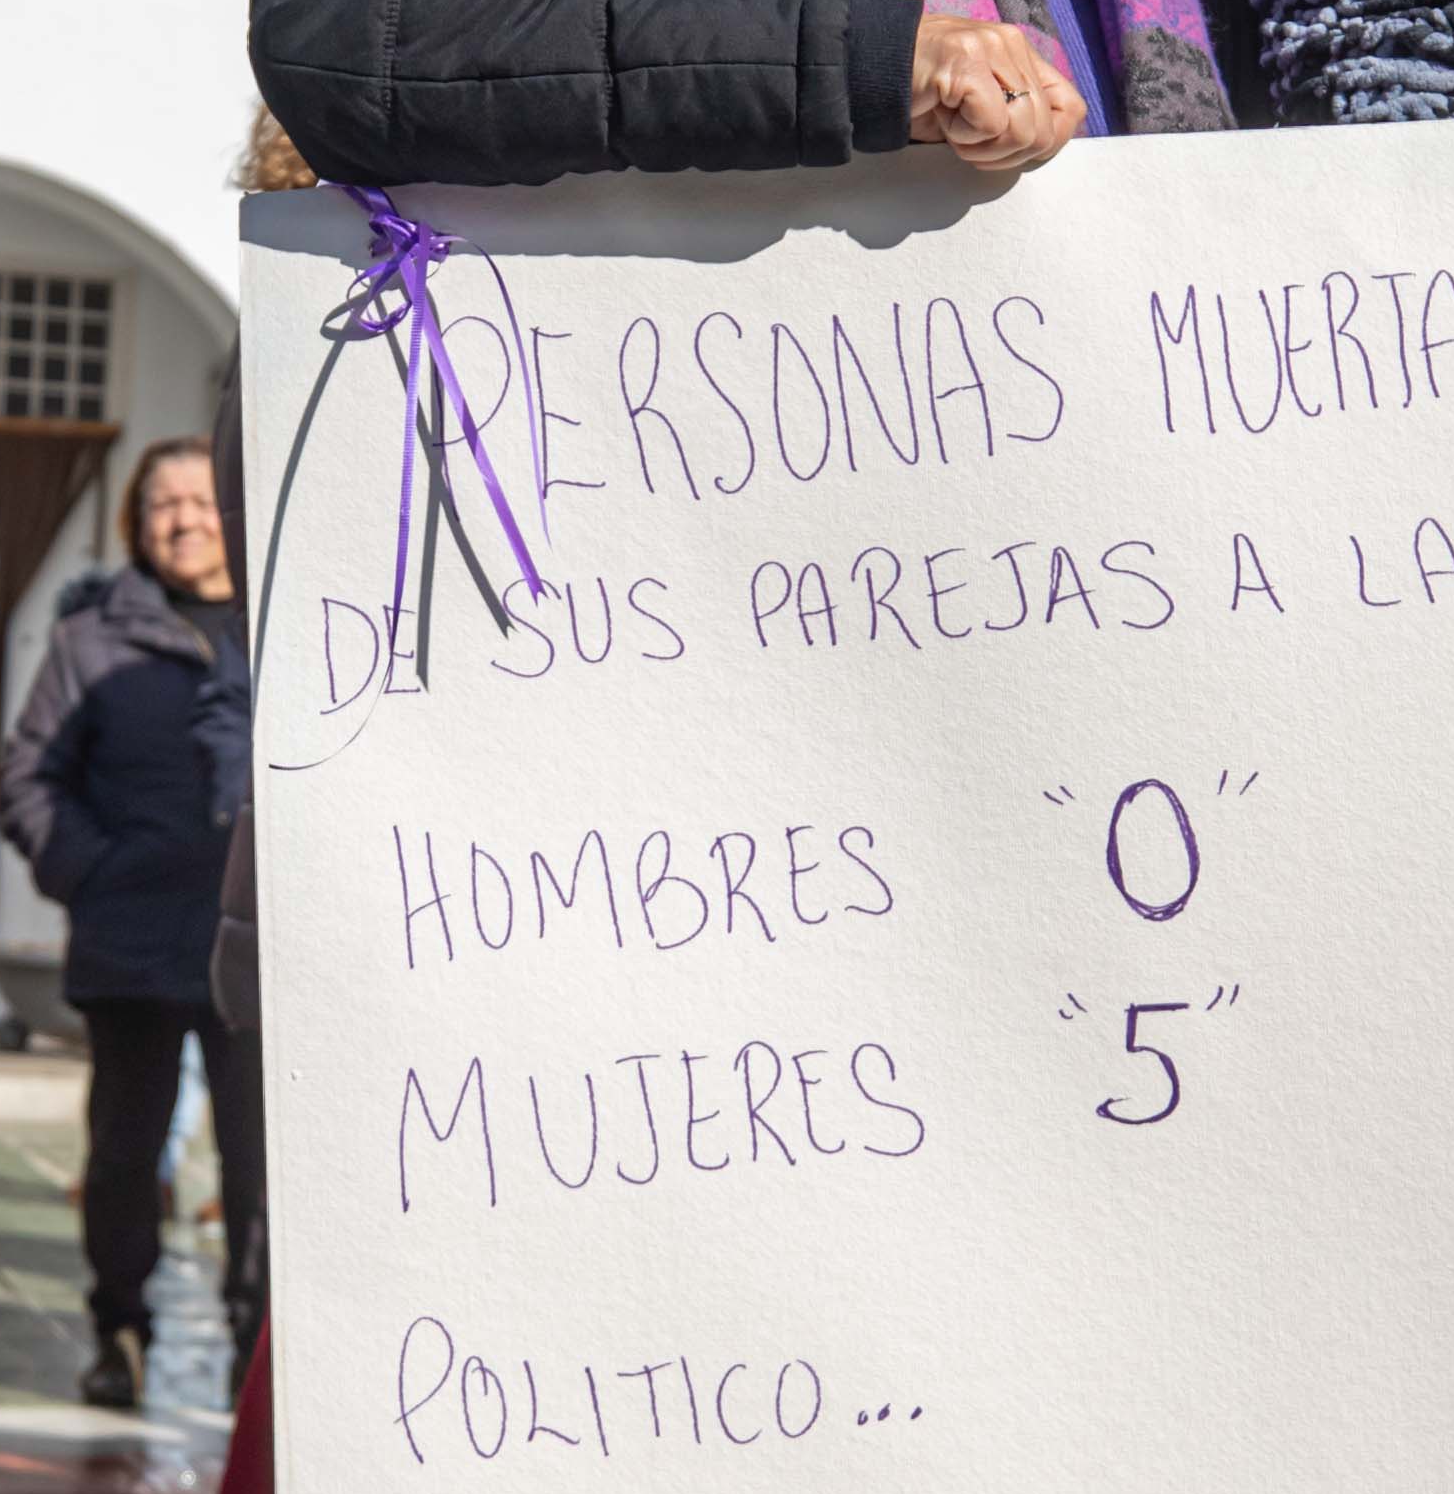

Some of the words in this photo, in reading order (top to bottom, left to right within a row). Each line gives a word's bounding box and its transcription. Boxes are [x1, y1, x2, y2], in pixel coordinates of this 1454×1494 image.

[432, 295, 1064, 523] PERSONAS
[319, 596, 421, 715] DE
[491, 576, 685, 679] SUS
[751, 541, 1175, 650] PAREJAS
[1231, 533, 1285, 614] A
[393, 823, 894, 969] HOMBRES
[400, 1040, 925, 1212] MUJERES
[395, 1316, 924, 1464] POLITICO...
